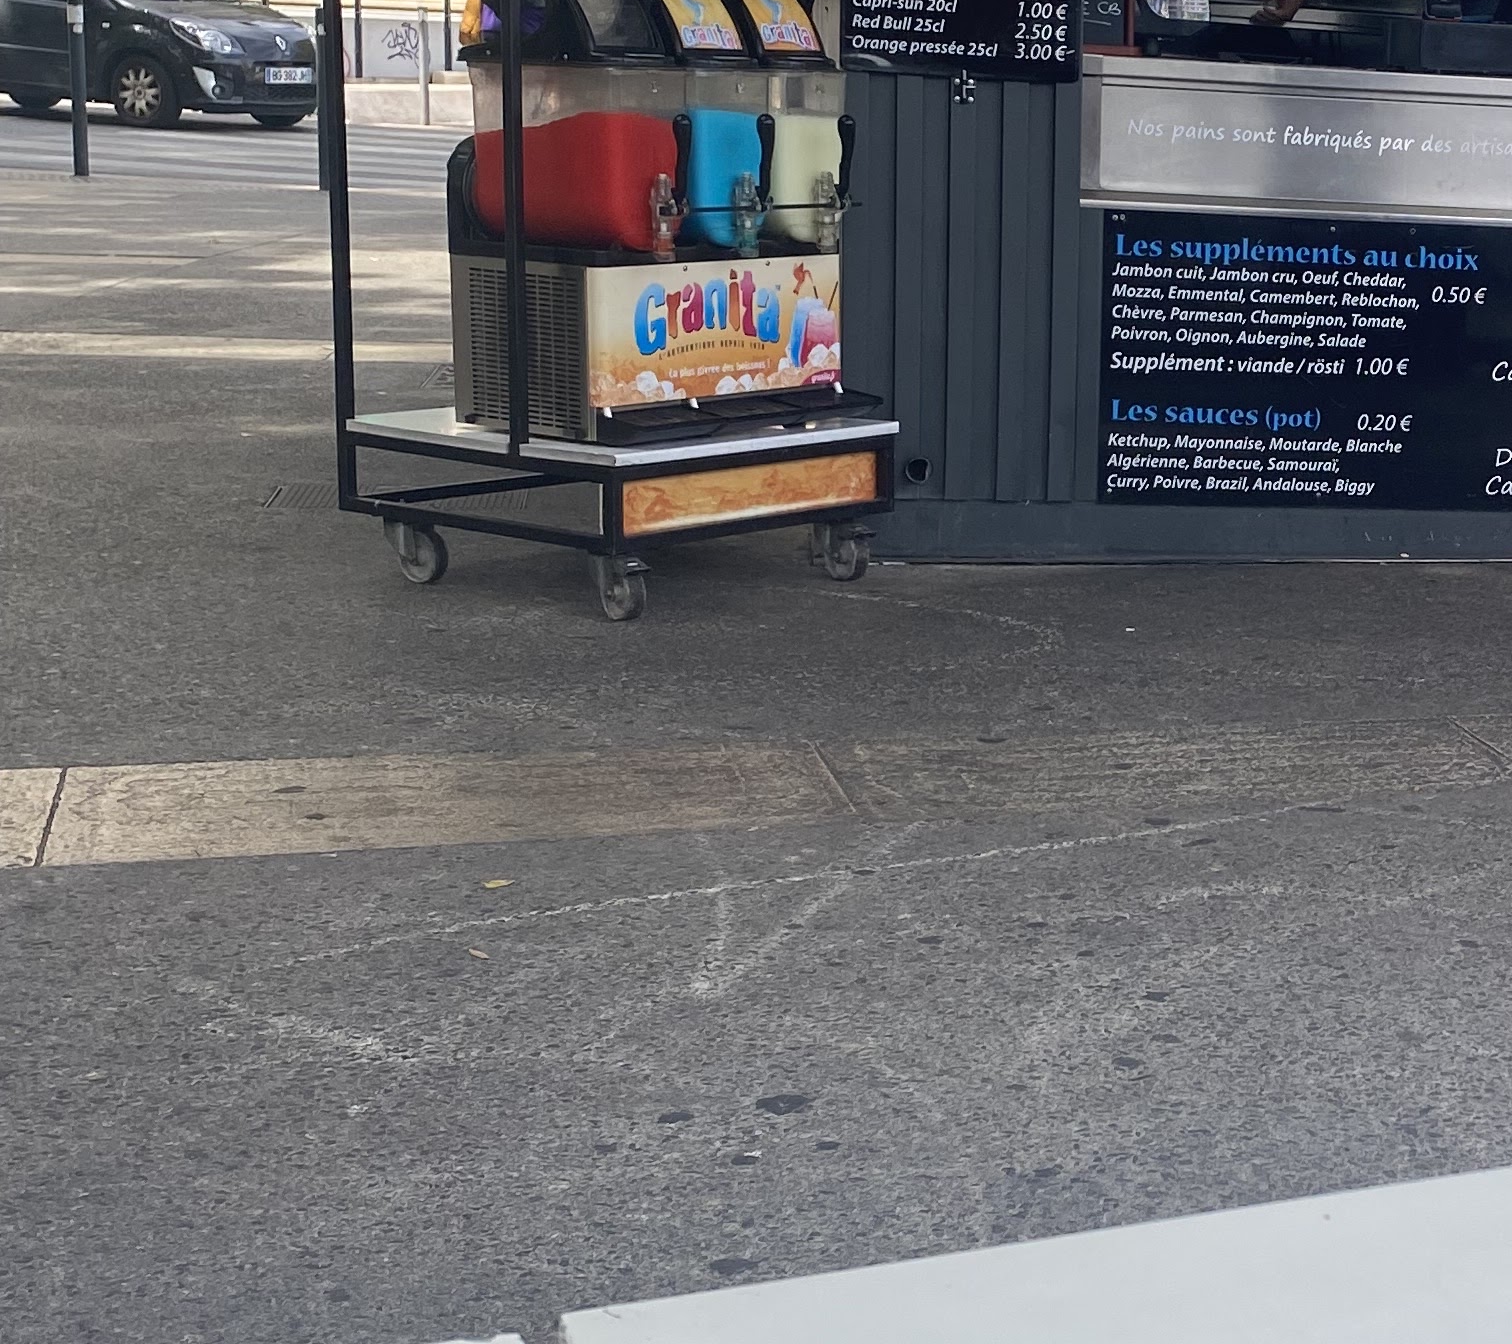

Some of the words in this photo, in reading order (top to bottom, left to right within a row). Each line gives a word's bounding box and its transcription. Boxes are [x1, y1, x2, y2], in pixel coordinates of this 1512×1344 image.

[682, 24, 735, 47] Granita
[762, 22, 812, 47] Granita
[852, 35, 907, 52] Orange
[909, 40, 965, 56] pressée
[967, 43, 998, 58] 25cl
[1128, 118, 1164, 138] Nos
[1171, 122, 1225, 144] pains
[1232, 125, 1276, 144] sont
[1283, 125, 1373, 152] fabriqués
[1379, 135, 1415, 156] par
[1421, 134, 1453, 154] des
[1115, 233, 1163, 257] Les
[1170, 238, 1356, 266] suppléments
[1364, 251, 1397, 268] au
[1405, 246, 1479, 271] choix
[634, 269, 780, 355] Granita
[1111, 399, 1157, 423] Les
[1165, 405, 1258, 426] sauces
[1265, 406, 1321, 431] (pot)
